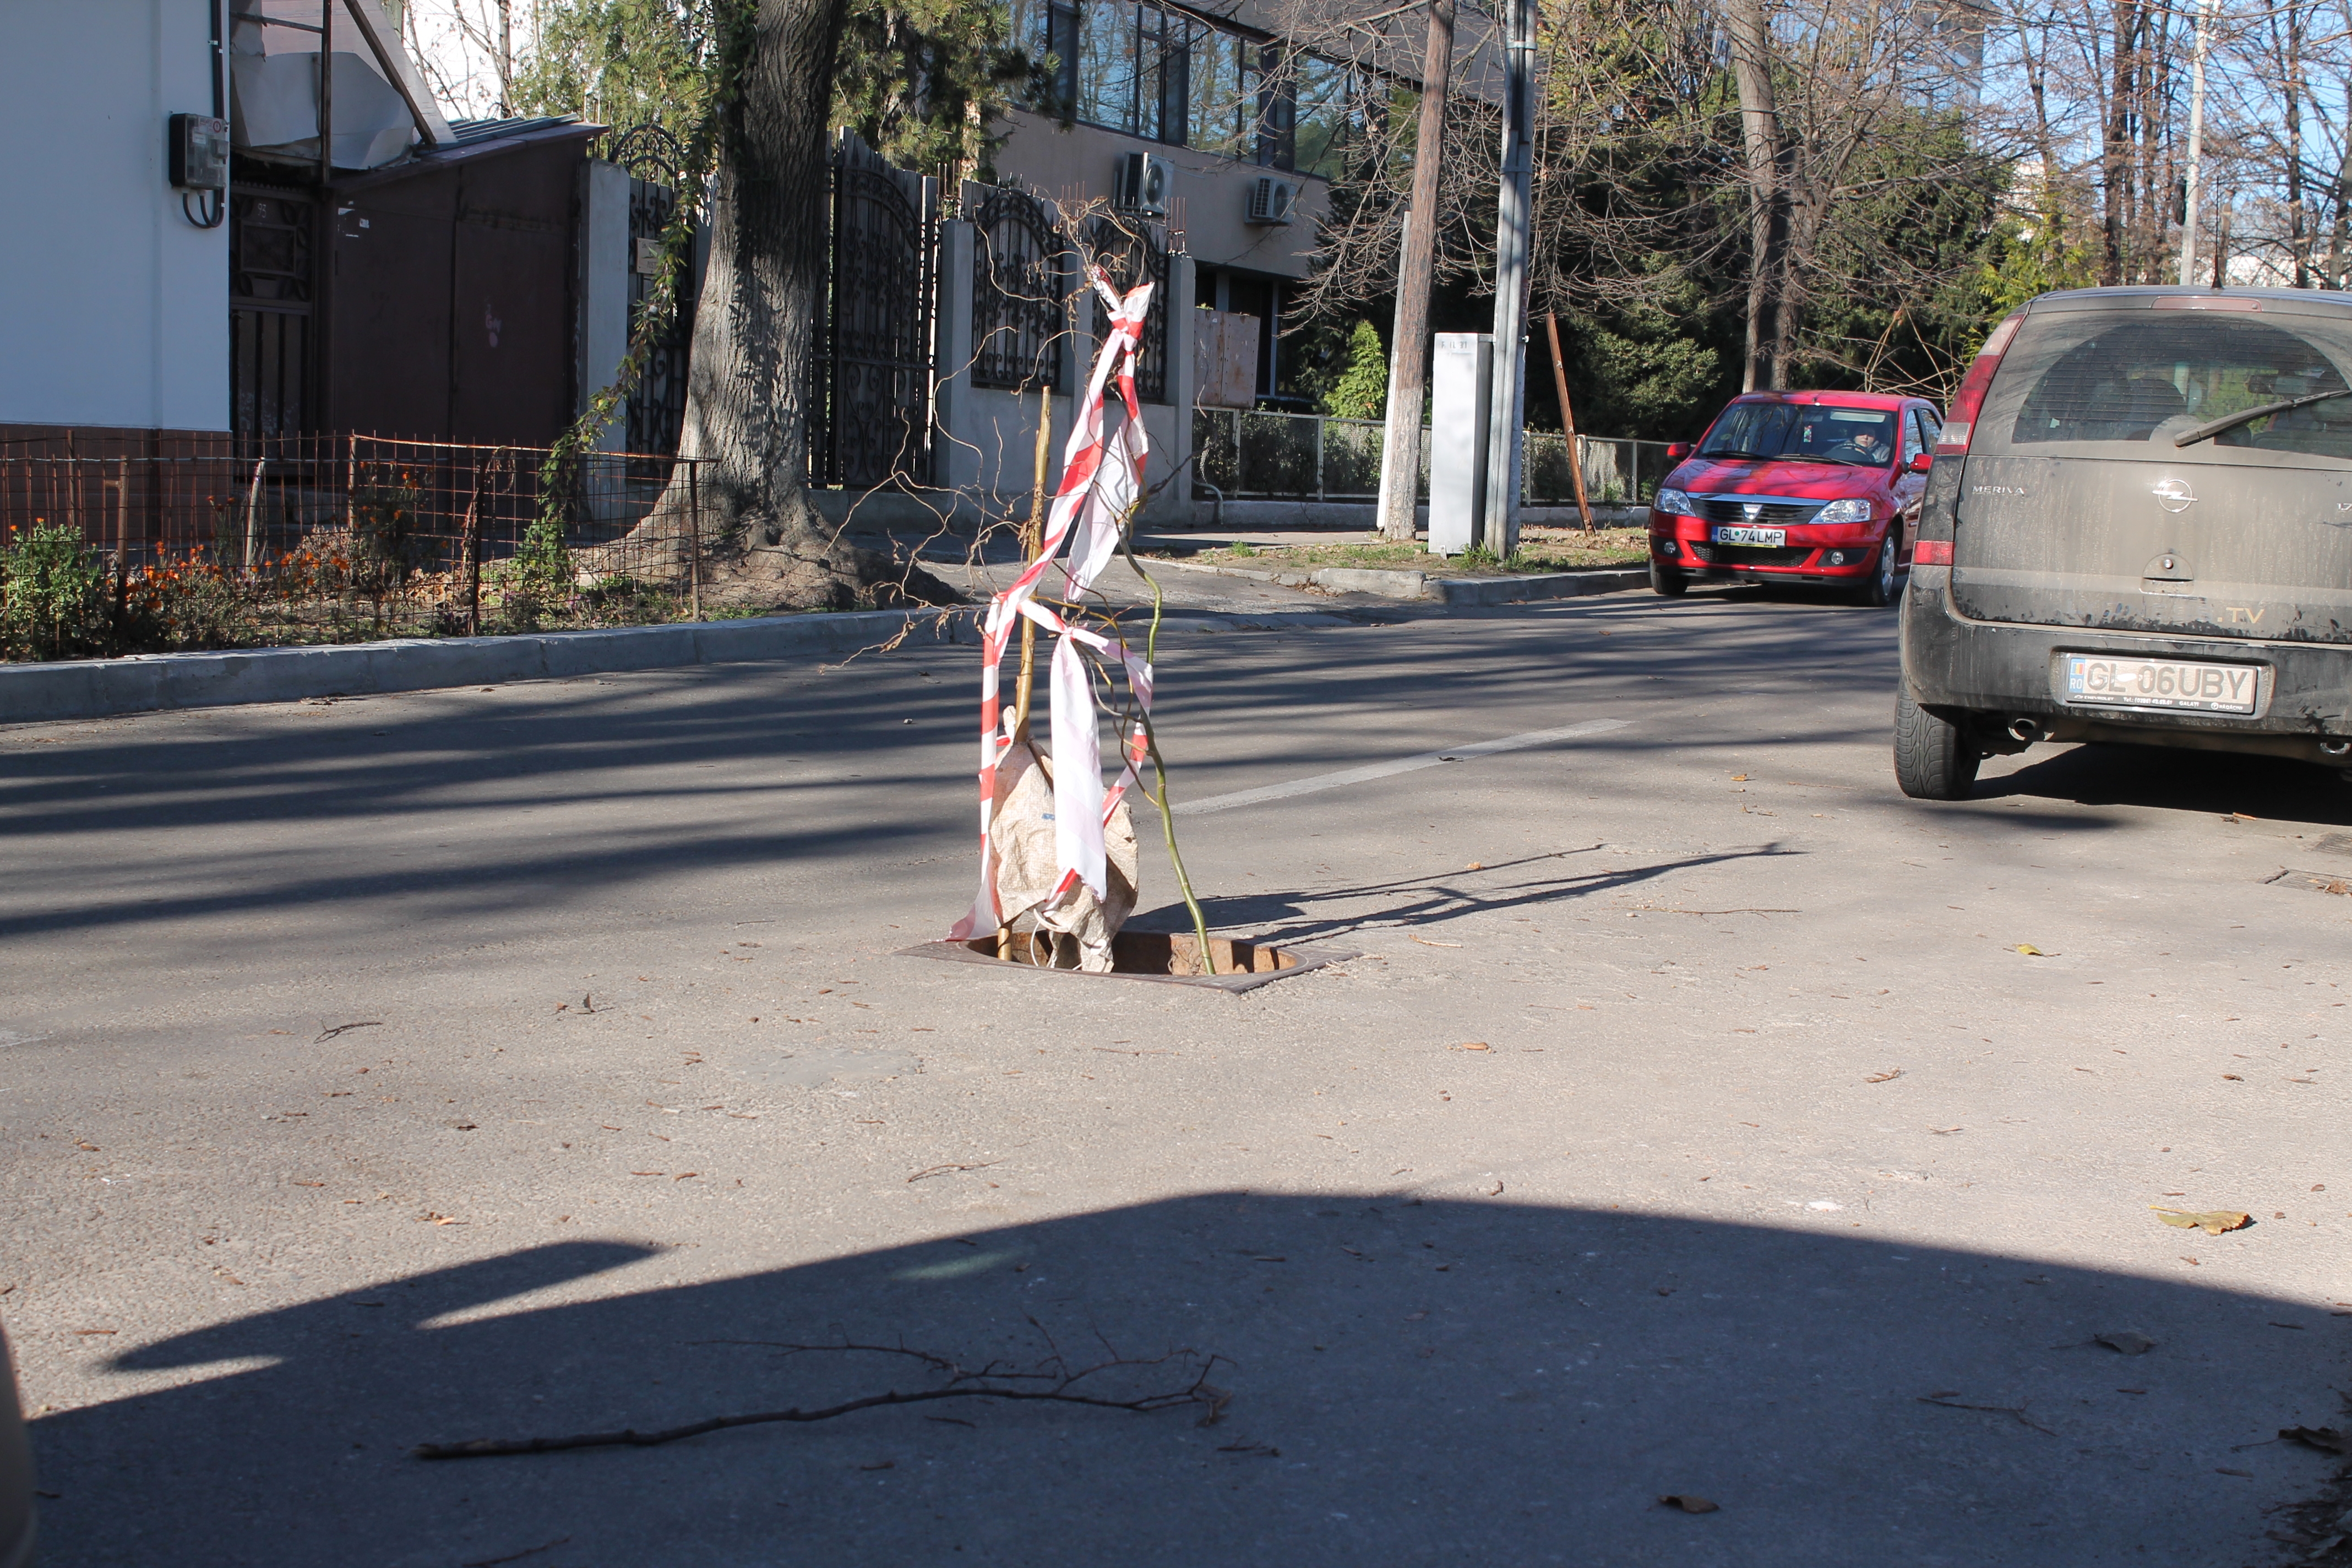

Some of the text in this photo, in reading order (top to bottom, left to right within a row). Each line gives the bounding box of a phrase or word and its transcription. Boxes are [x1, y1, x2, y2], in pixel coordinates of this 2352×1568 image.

[258, 203, 266, 218] 93
[1972, 486, 2025, 495] MERIVA
[1720, 529, 1735, 541] GL
[2069, 677, 2083, 690] RO
[2087, 662, 2127, 693] GL
